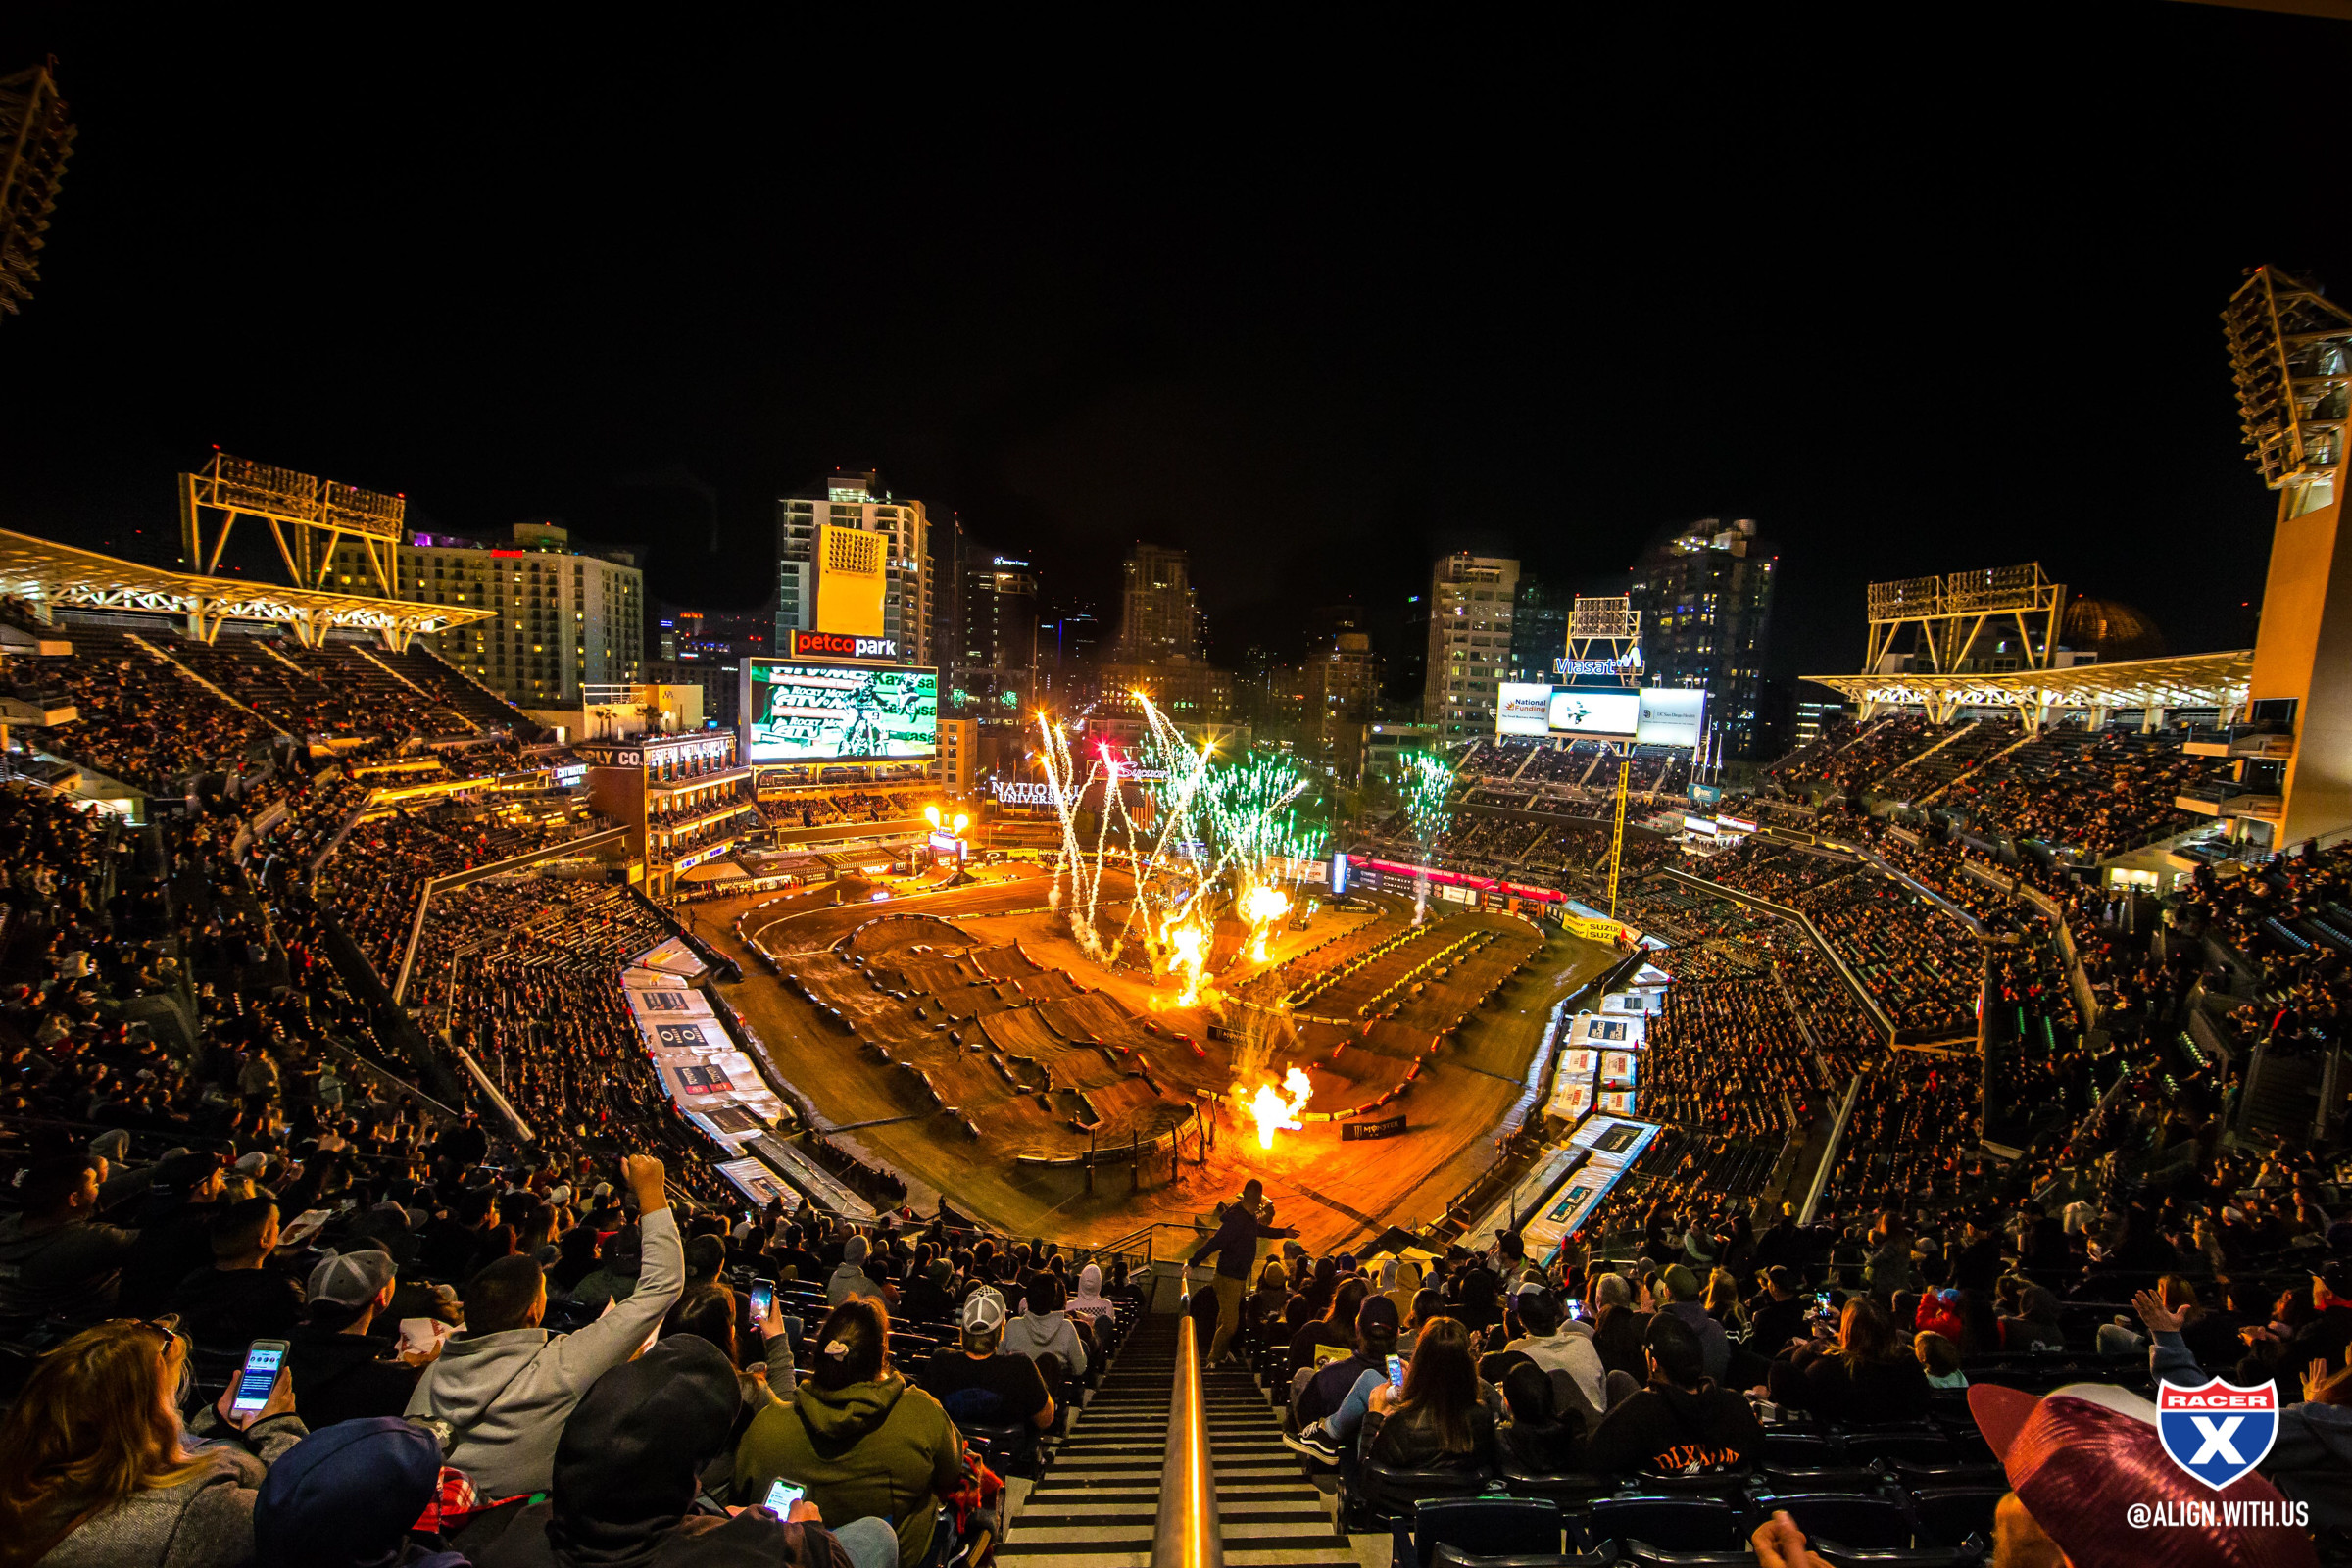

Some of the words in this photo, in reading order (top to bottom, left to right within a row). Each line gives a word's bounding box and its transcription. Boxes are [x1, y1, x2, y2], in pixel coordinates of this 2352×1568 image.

[1556, 658, 1616, 675] Viasat
[1515, 705, 1546, 713] Funding
[645, 747, 678, 761] WESTERN
[680, 744, 701, 757] METAL
[702, 740, 724, 754] SUPPLY
[618, 752, 644, 766] CO.
[1590, 924, 1621, 934] SUZUKI
[1363, 1120, 1399, 1133] MONSTER
